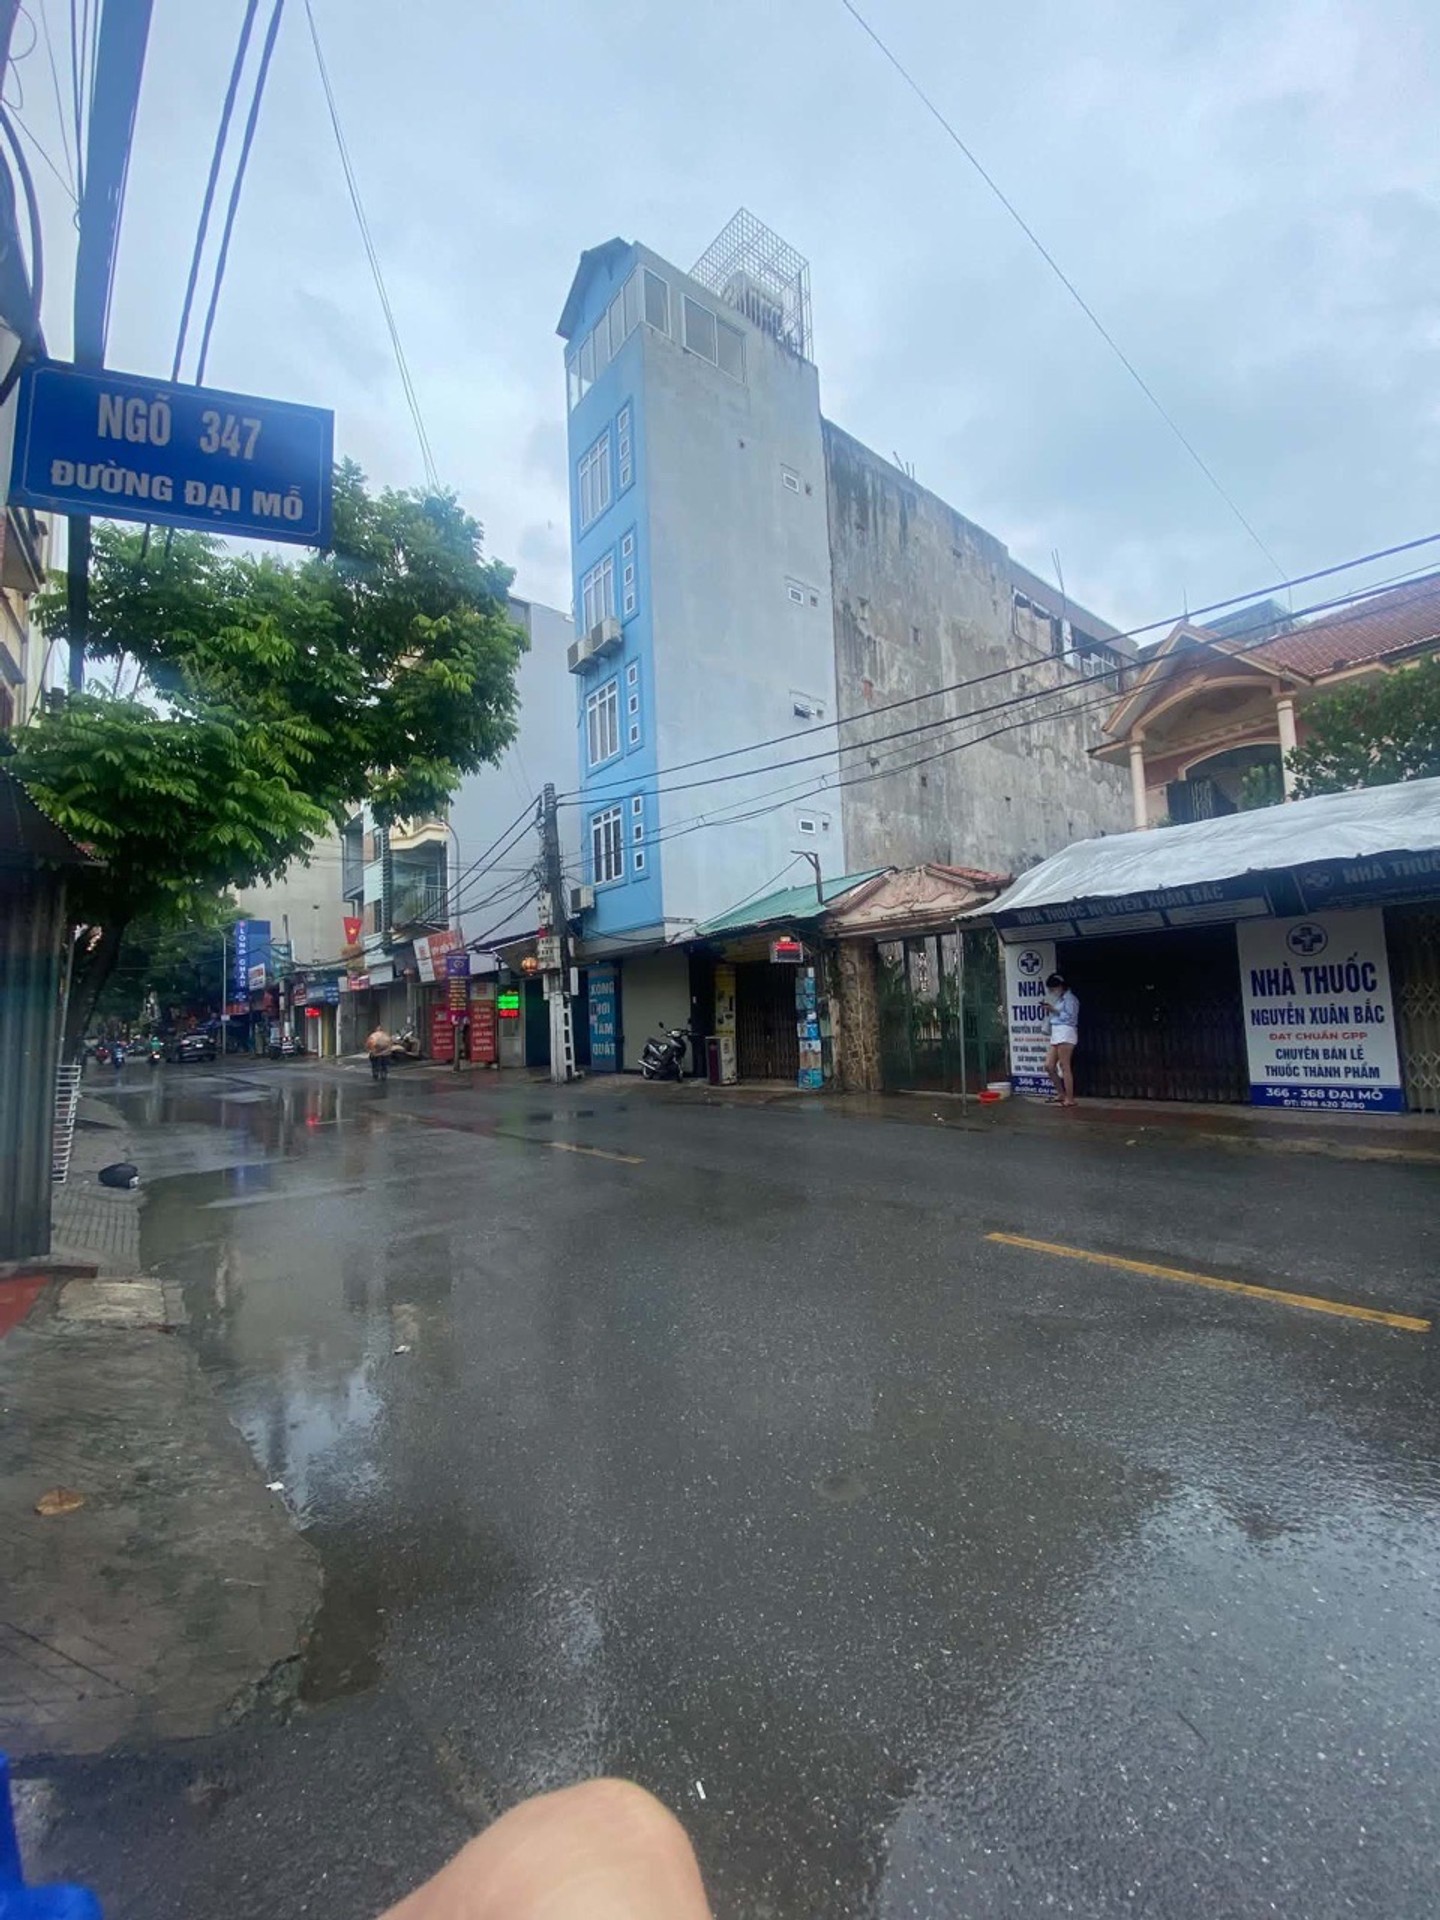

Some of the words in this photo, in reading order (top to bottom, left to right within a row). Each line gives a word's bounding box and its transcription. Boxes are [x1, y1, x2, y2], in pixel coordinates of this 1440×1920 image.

[97, 392, 172, 447] NGÕ
[199, 410, 263, 460] 347
[50, 458, 173, 502] ĐƯỜNG
[183, 480, 241, 516] ĐẠI
[252, 485, 304, 521] MỖ
[1251, 961, 1296, 997] NHÀ
[1301, 952, 1377, 995] THUỐC
[1018, 977, 1046, 997] NHÀ
[1309, 1003, 1350, 1025] XUÂN
[1353, 998, 1385, 1024] BẮC
[1342, 1032, 1368, 1041] GPP
[1275, 1046, 1319, 1060] CHUYÊN
[1323, 1046, 1347, 1060] BÁN
[1350, 1044, 1364, 1060] LẺ
[1264, 1062, 1300, 1077] THUỐC
[1302, 1064, 1341, 1078] THÀNH
[1344, 1062, 1380, 1079] PHẨM
[1266, 1087, 1289, 1098] 366
[1300, 1089, 1325, 1099] 368
